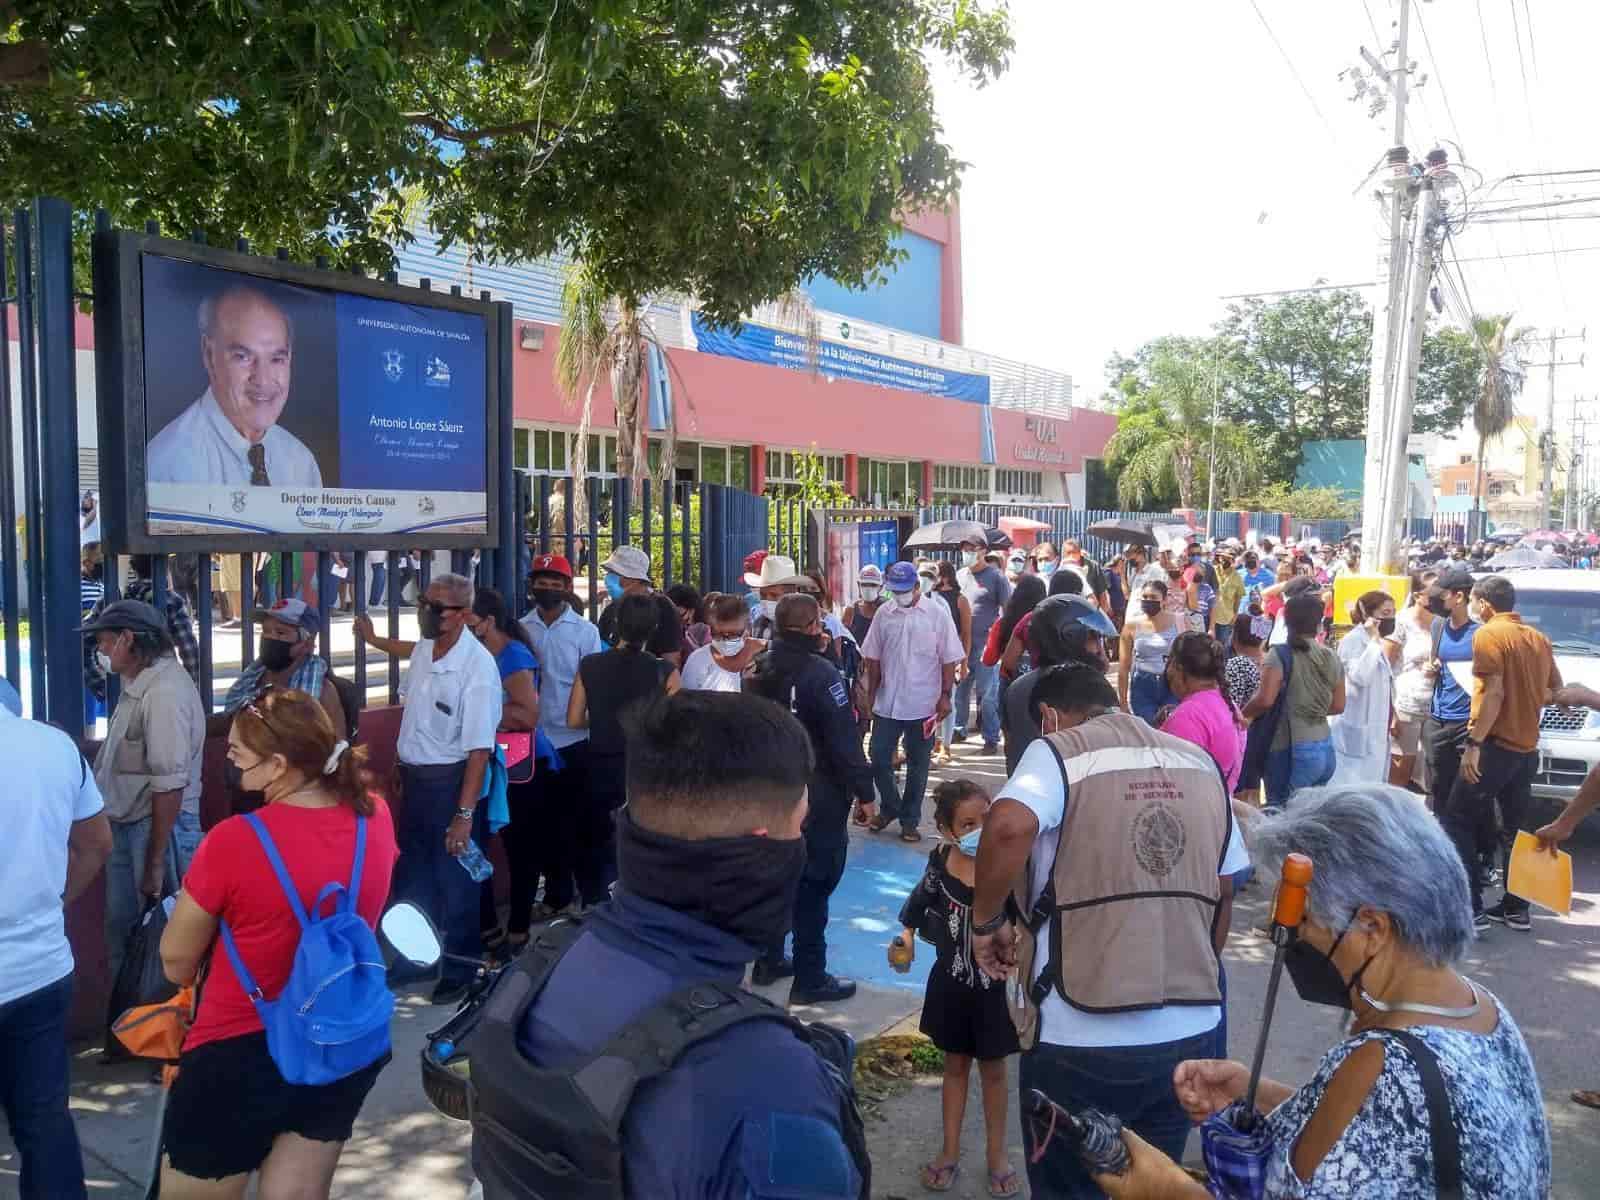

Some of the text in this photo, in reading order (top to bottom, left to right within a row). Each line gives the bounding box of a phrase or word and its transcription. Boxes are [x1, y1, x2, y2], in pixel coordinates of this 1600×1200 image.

[369, 414, 408, 430] Antonio
[281, 492, 397, 506] Doctor Honoris Causa
